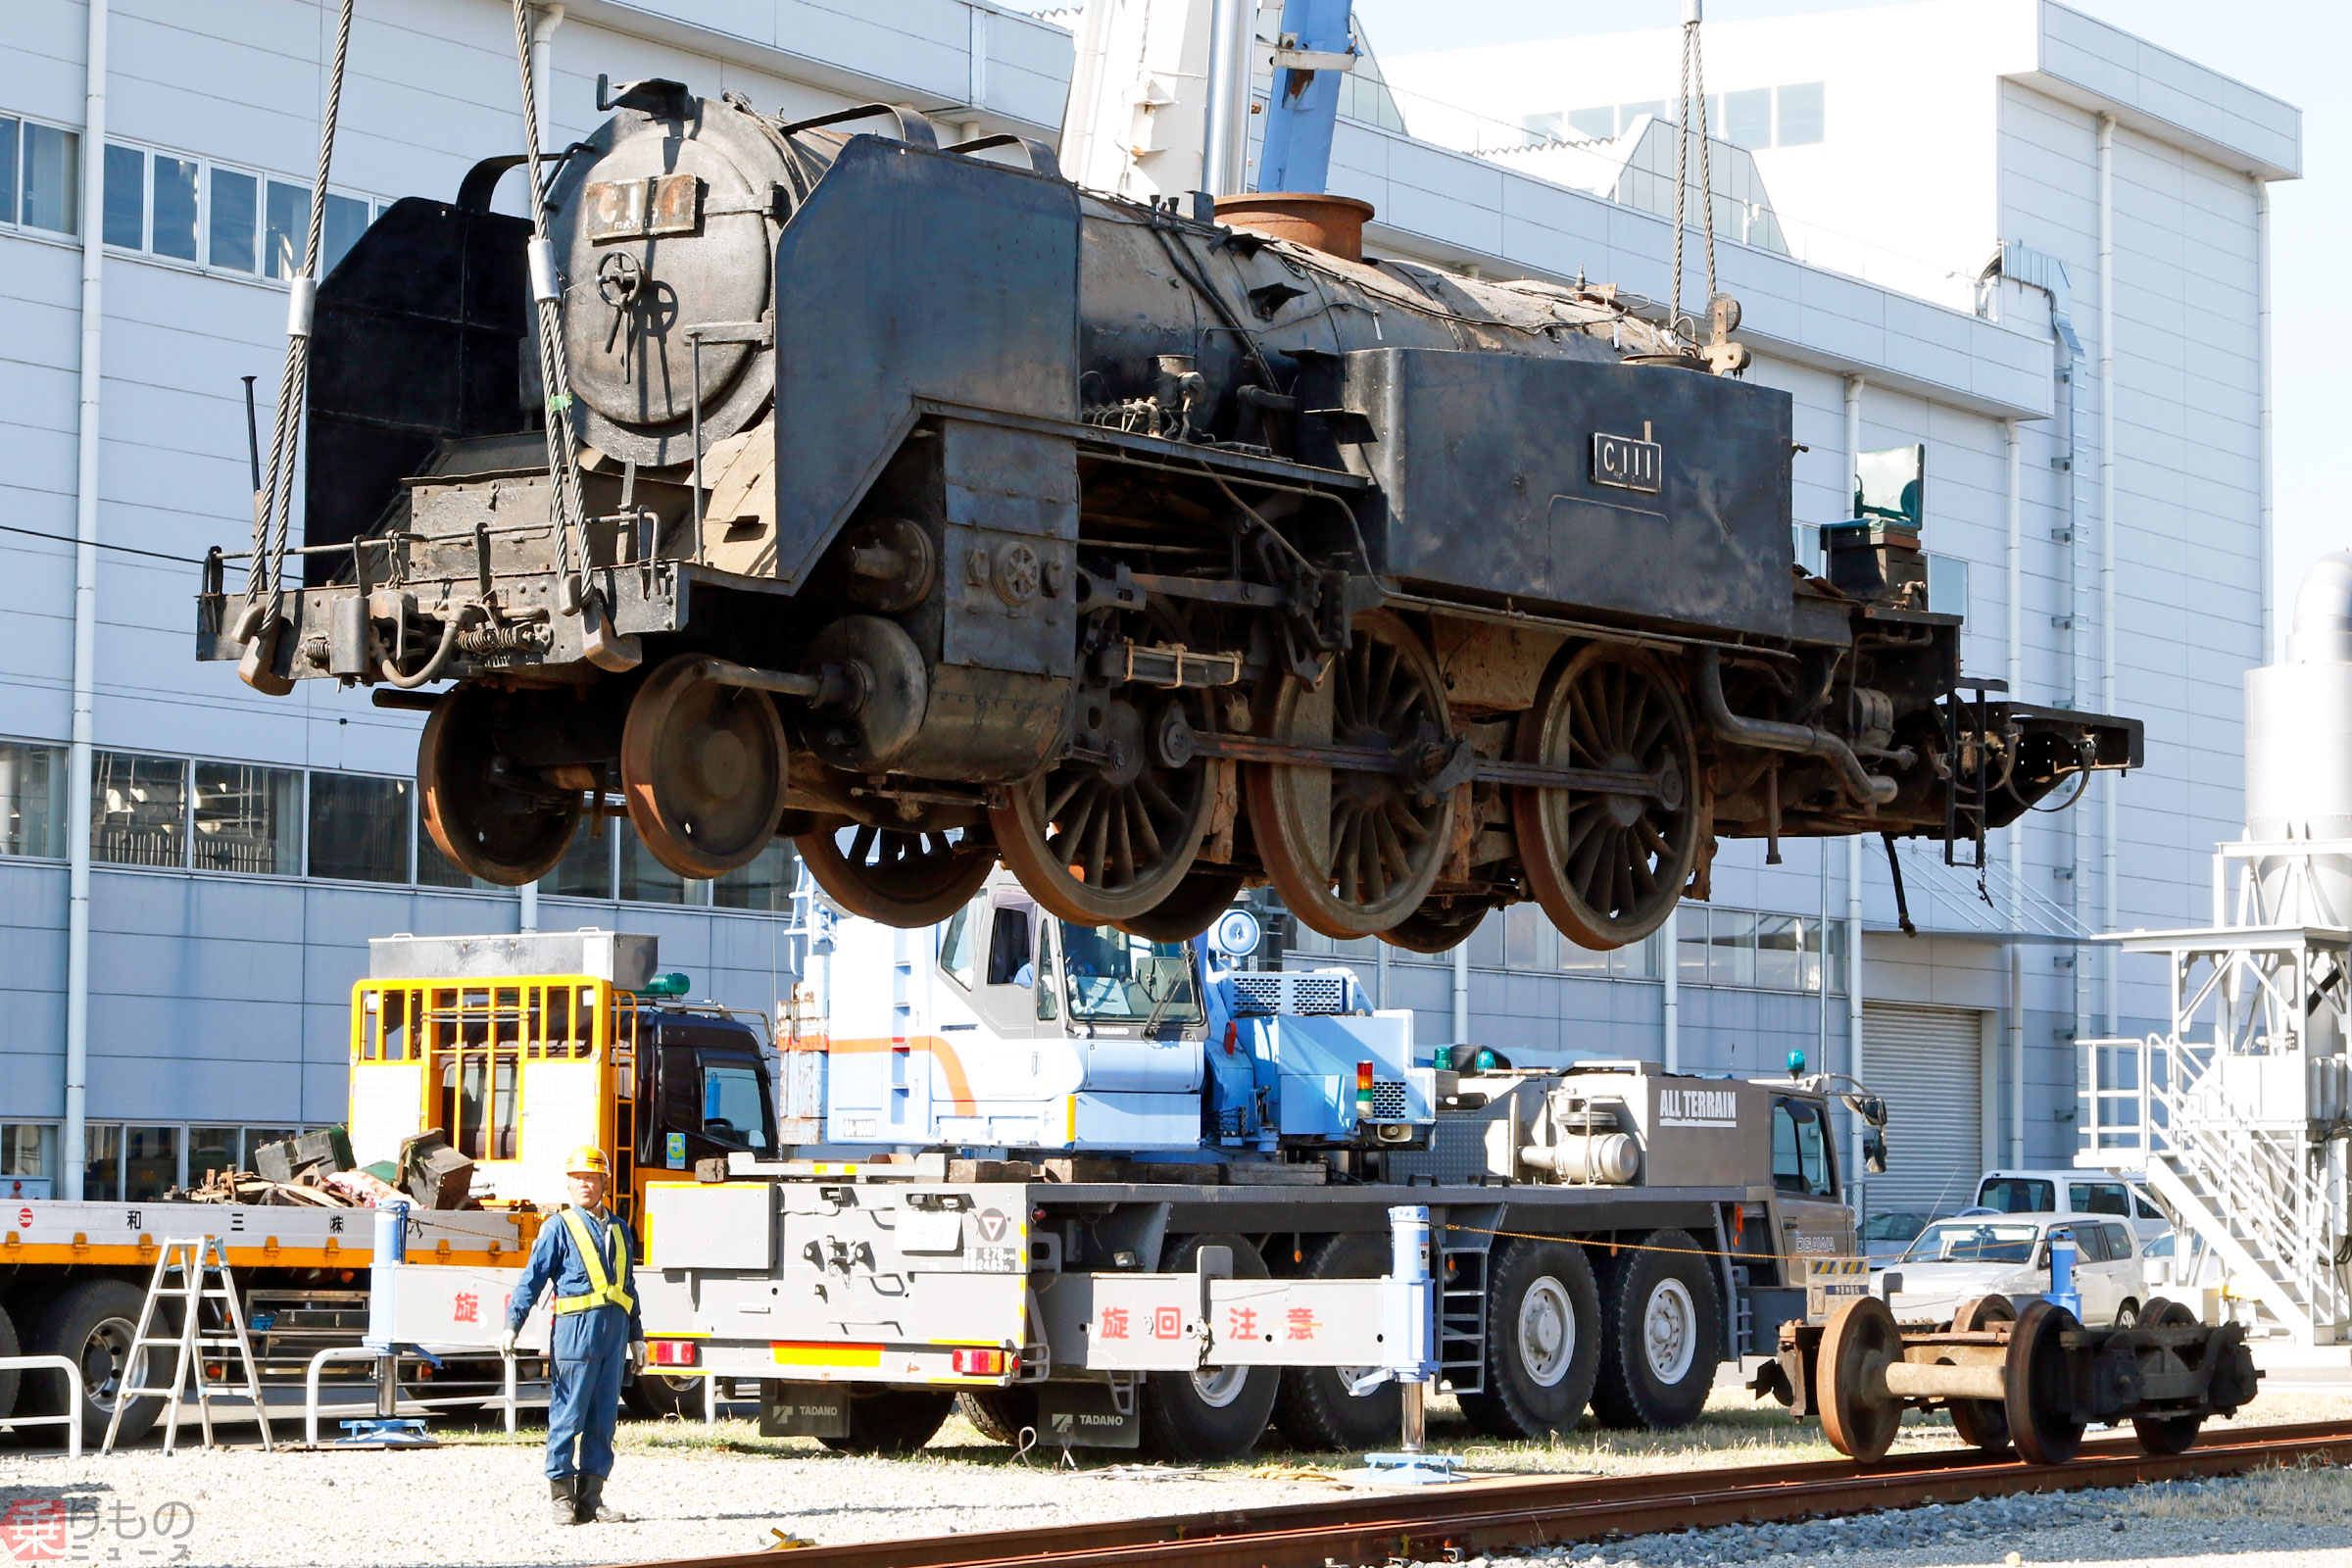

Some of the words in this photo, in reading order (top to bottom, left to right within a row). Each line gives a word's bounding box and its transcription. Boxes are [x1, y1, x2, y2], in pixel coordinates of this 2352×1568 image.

[1603, 441, 1651, 479] C111
[1095, 1027, 1130, 1036] TADANO
[1659, 1090, 1682, 1117] ALL
[1683, 1090, 1737, 1118] TERRAIN
[126, 1210, 142, 1230] 和
[1796, 1237, 1836, 1252] OGAWA
[799, 1405, 838, 1417] TADANO
[1079, 1414, 1124, 1427] TADANO
